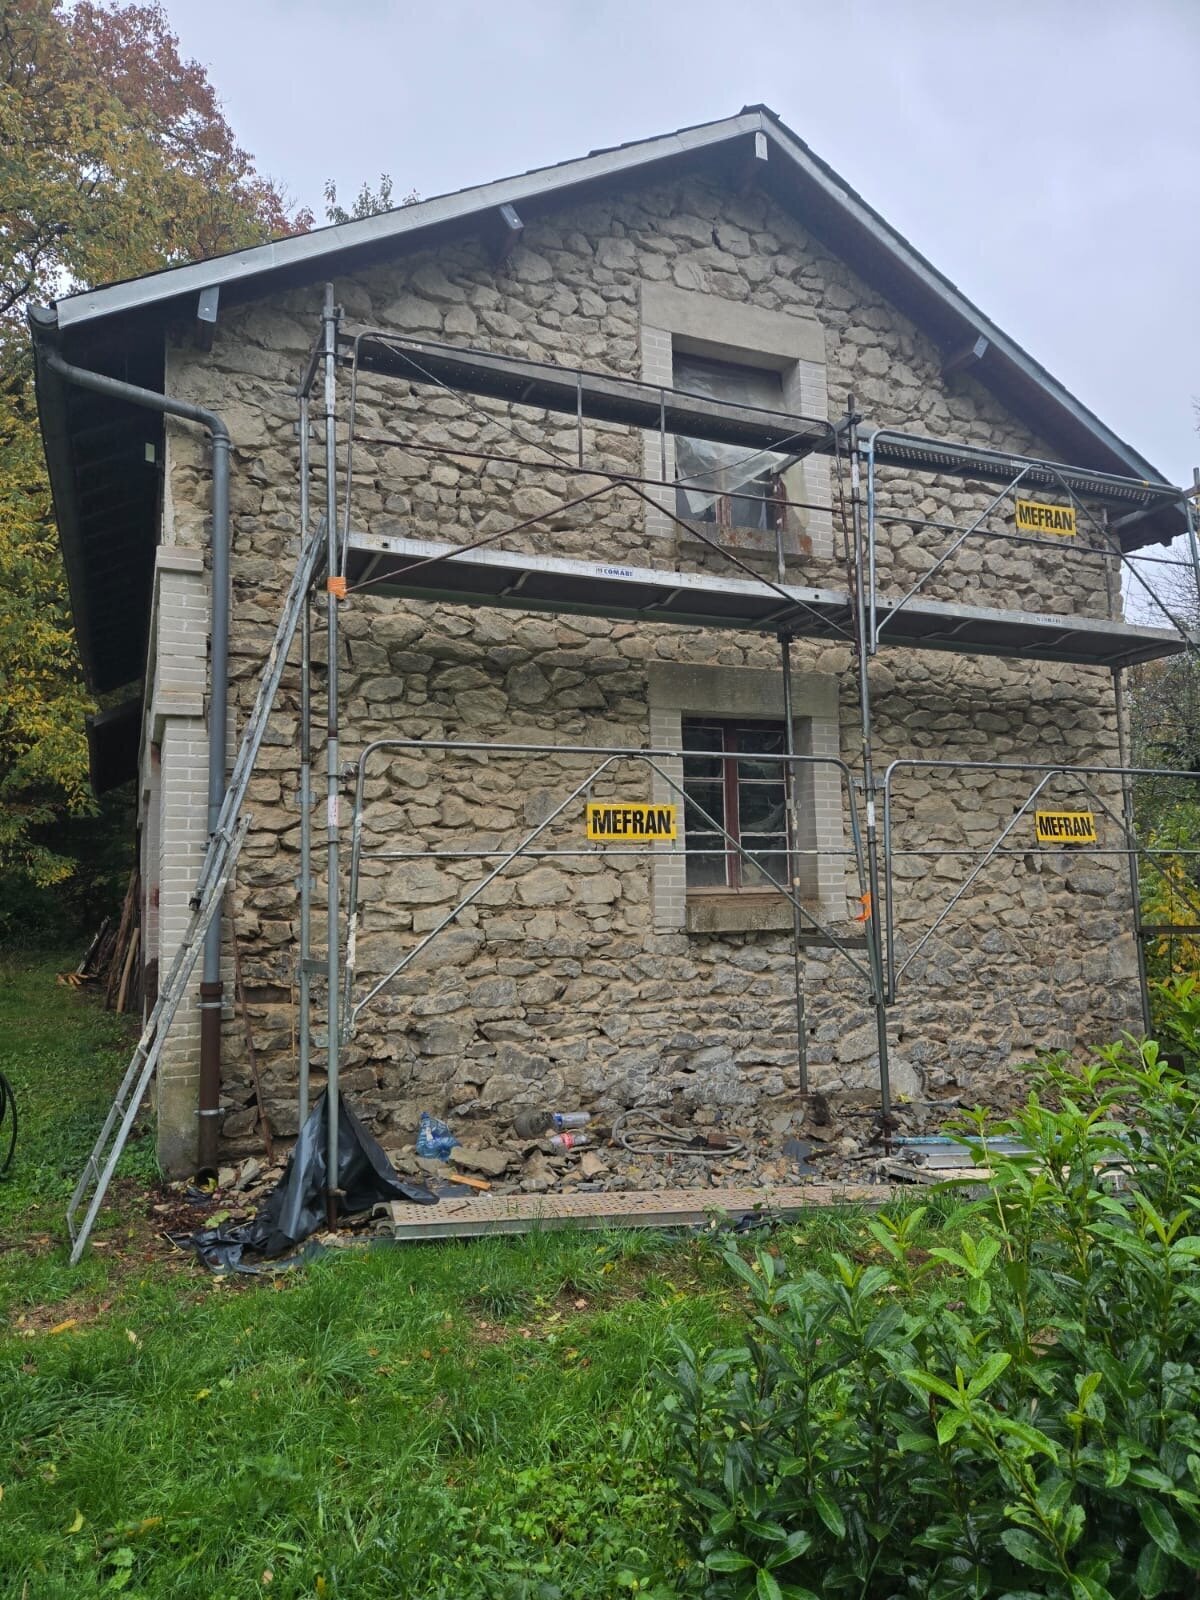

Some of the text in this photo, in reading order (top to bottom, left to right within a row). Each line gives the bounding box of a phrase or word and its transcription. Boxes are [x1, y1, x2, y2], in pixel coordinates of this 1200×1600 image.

[1018, 503, 1073, 531] MEFRAN
[592, 809, 672, 834] MEFRAN
[1038, 815, 1093, 837] MEFRAN
